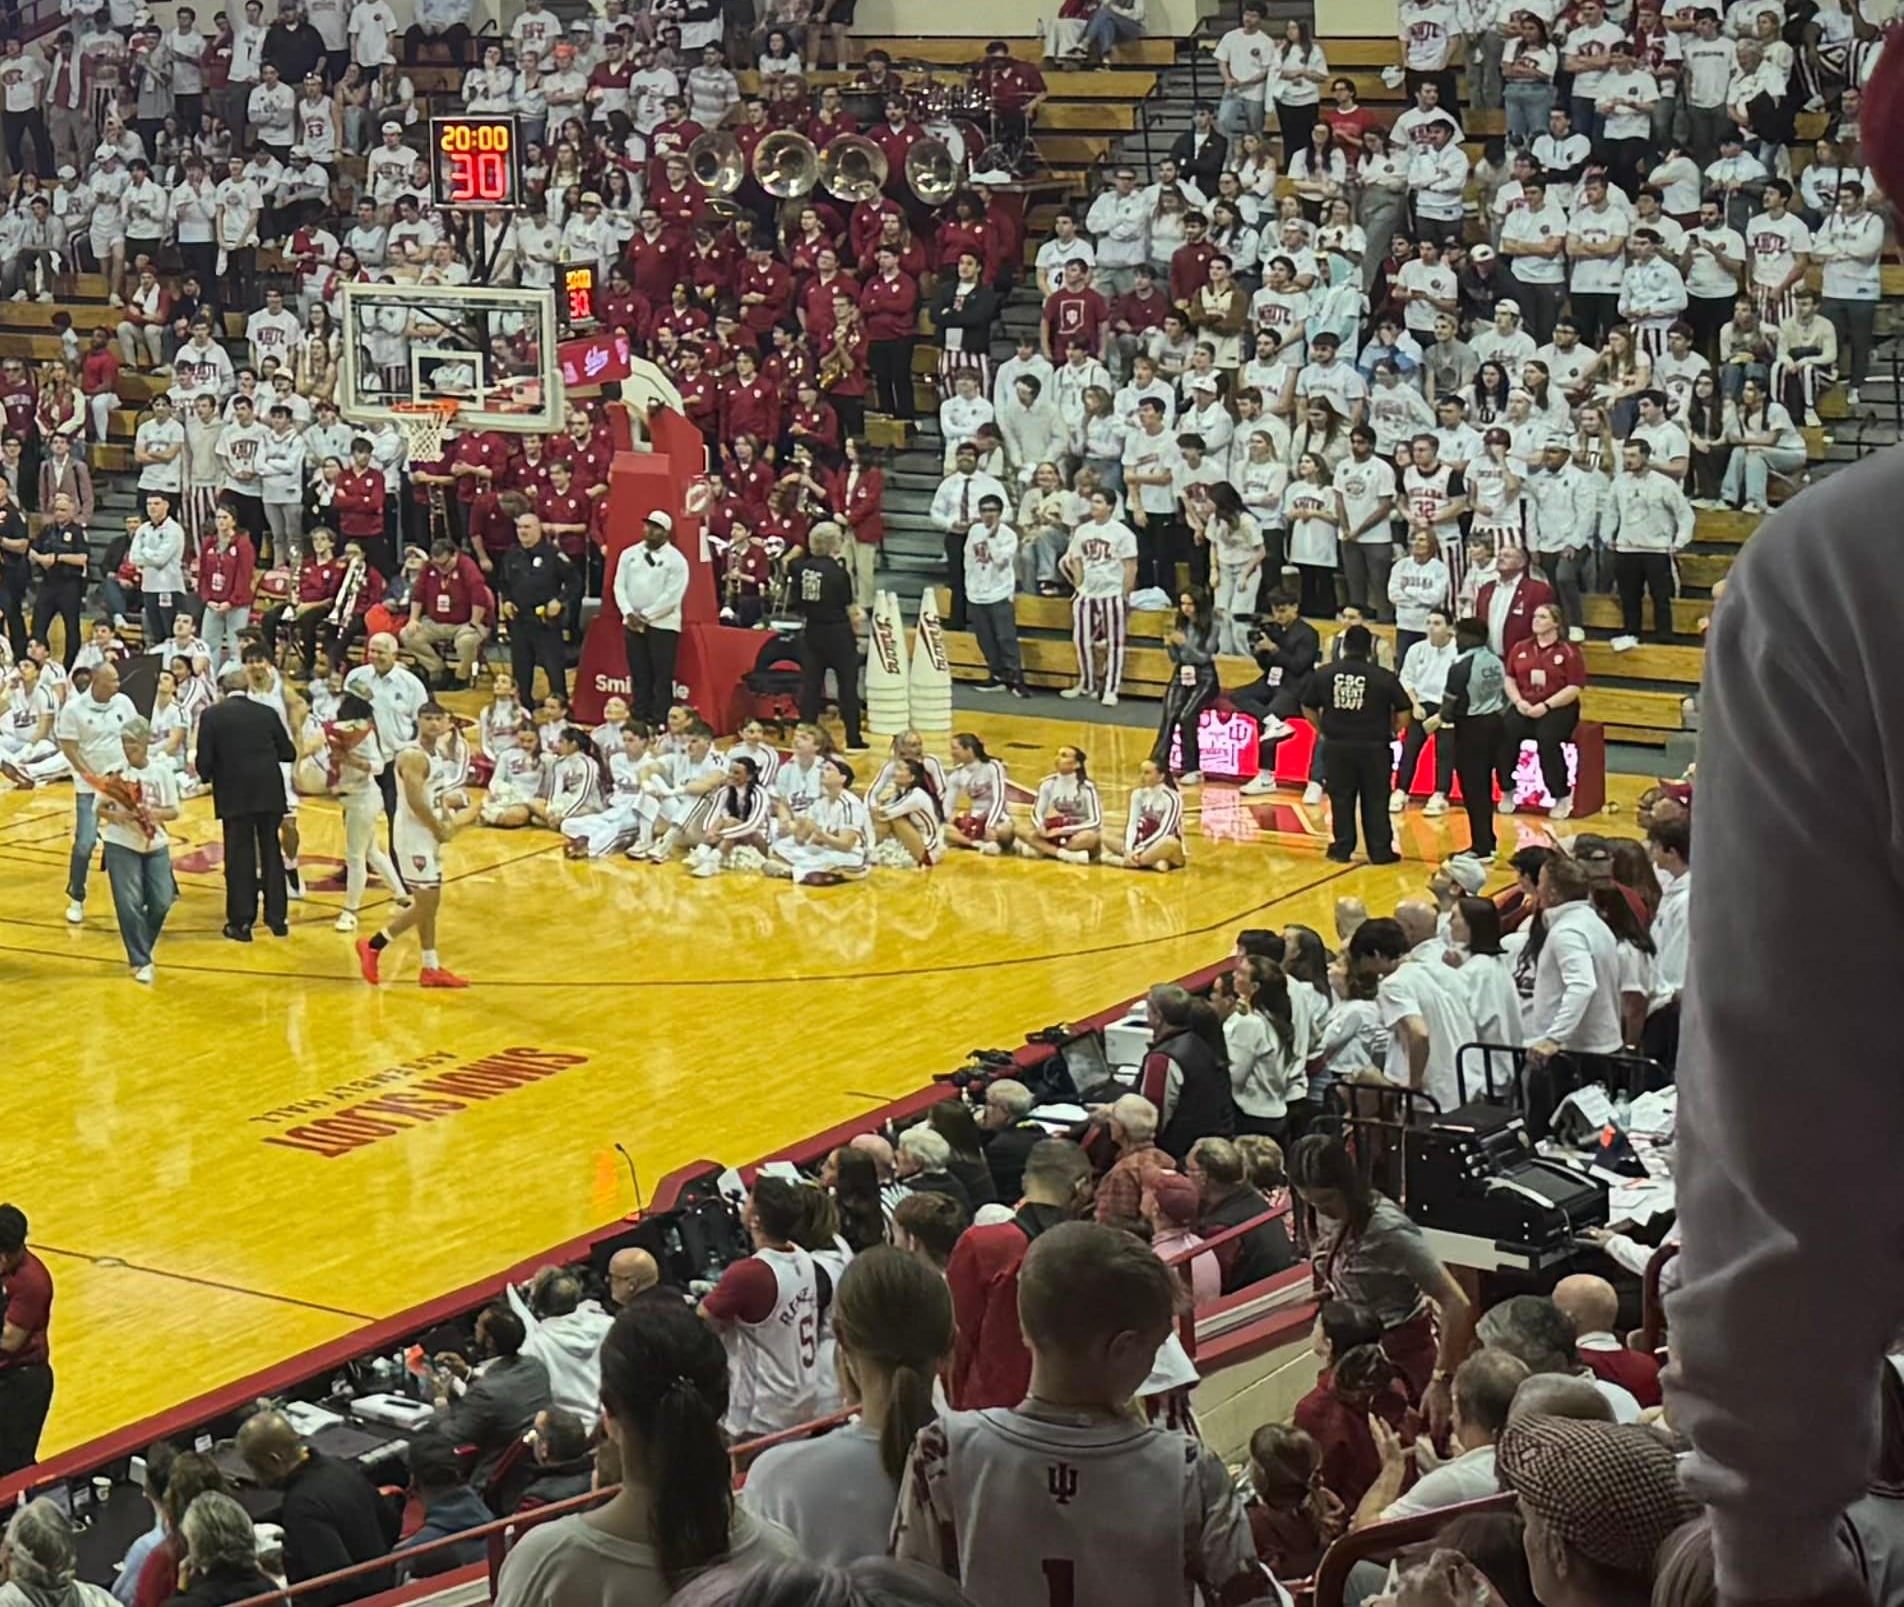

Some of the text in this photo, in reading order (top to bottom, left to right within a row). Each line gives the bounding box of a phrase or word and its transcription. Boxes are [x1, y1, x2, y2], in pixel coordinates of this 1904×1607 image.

[441, 125, 509, 152] 20:00
[451, 153, 506, 202] 30
[411, 1047, 589, 1101] SIMON
[249, 1097, 329, 1124] HALL
